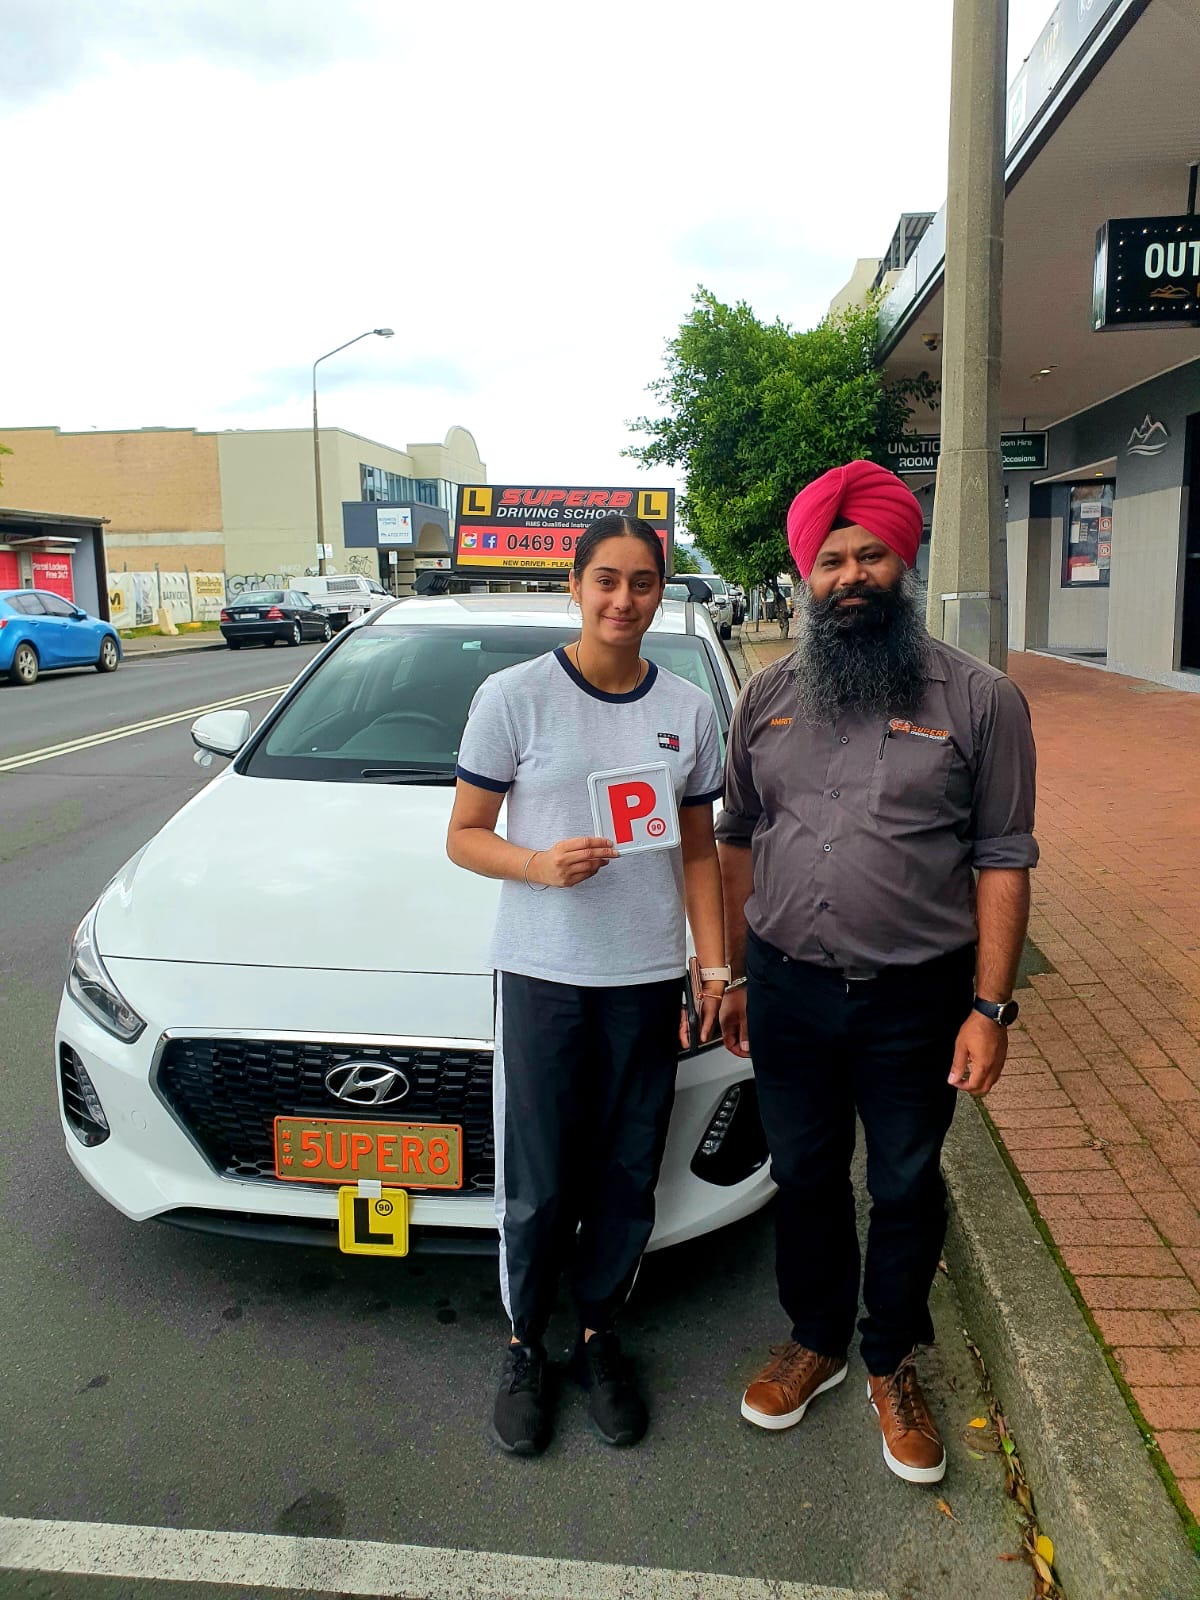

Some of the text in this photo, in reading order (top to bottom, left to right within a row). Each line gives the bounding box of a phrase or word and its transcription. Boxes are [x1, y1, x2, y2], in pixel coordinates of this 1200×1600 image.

[888, 440, 940, 454] UNCTIO
[899, 457, 934, 467] ROOM
[468, 490, 486, 512] L
[498, 488, 633, 508] SUPERB
[644, 493, 661, 516] L
[496, 507, 559, 519] DRIVING
[541, 520, 570, 528] Qualified
[507, 534, 554, 551] 0469
[608, 781, 656, 844] P
[651, 823, 662, 831] 90
[353, 1197, 394, 1245] L
